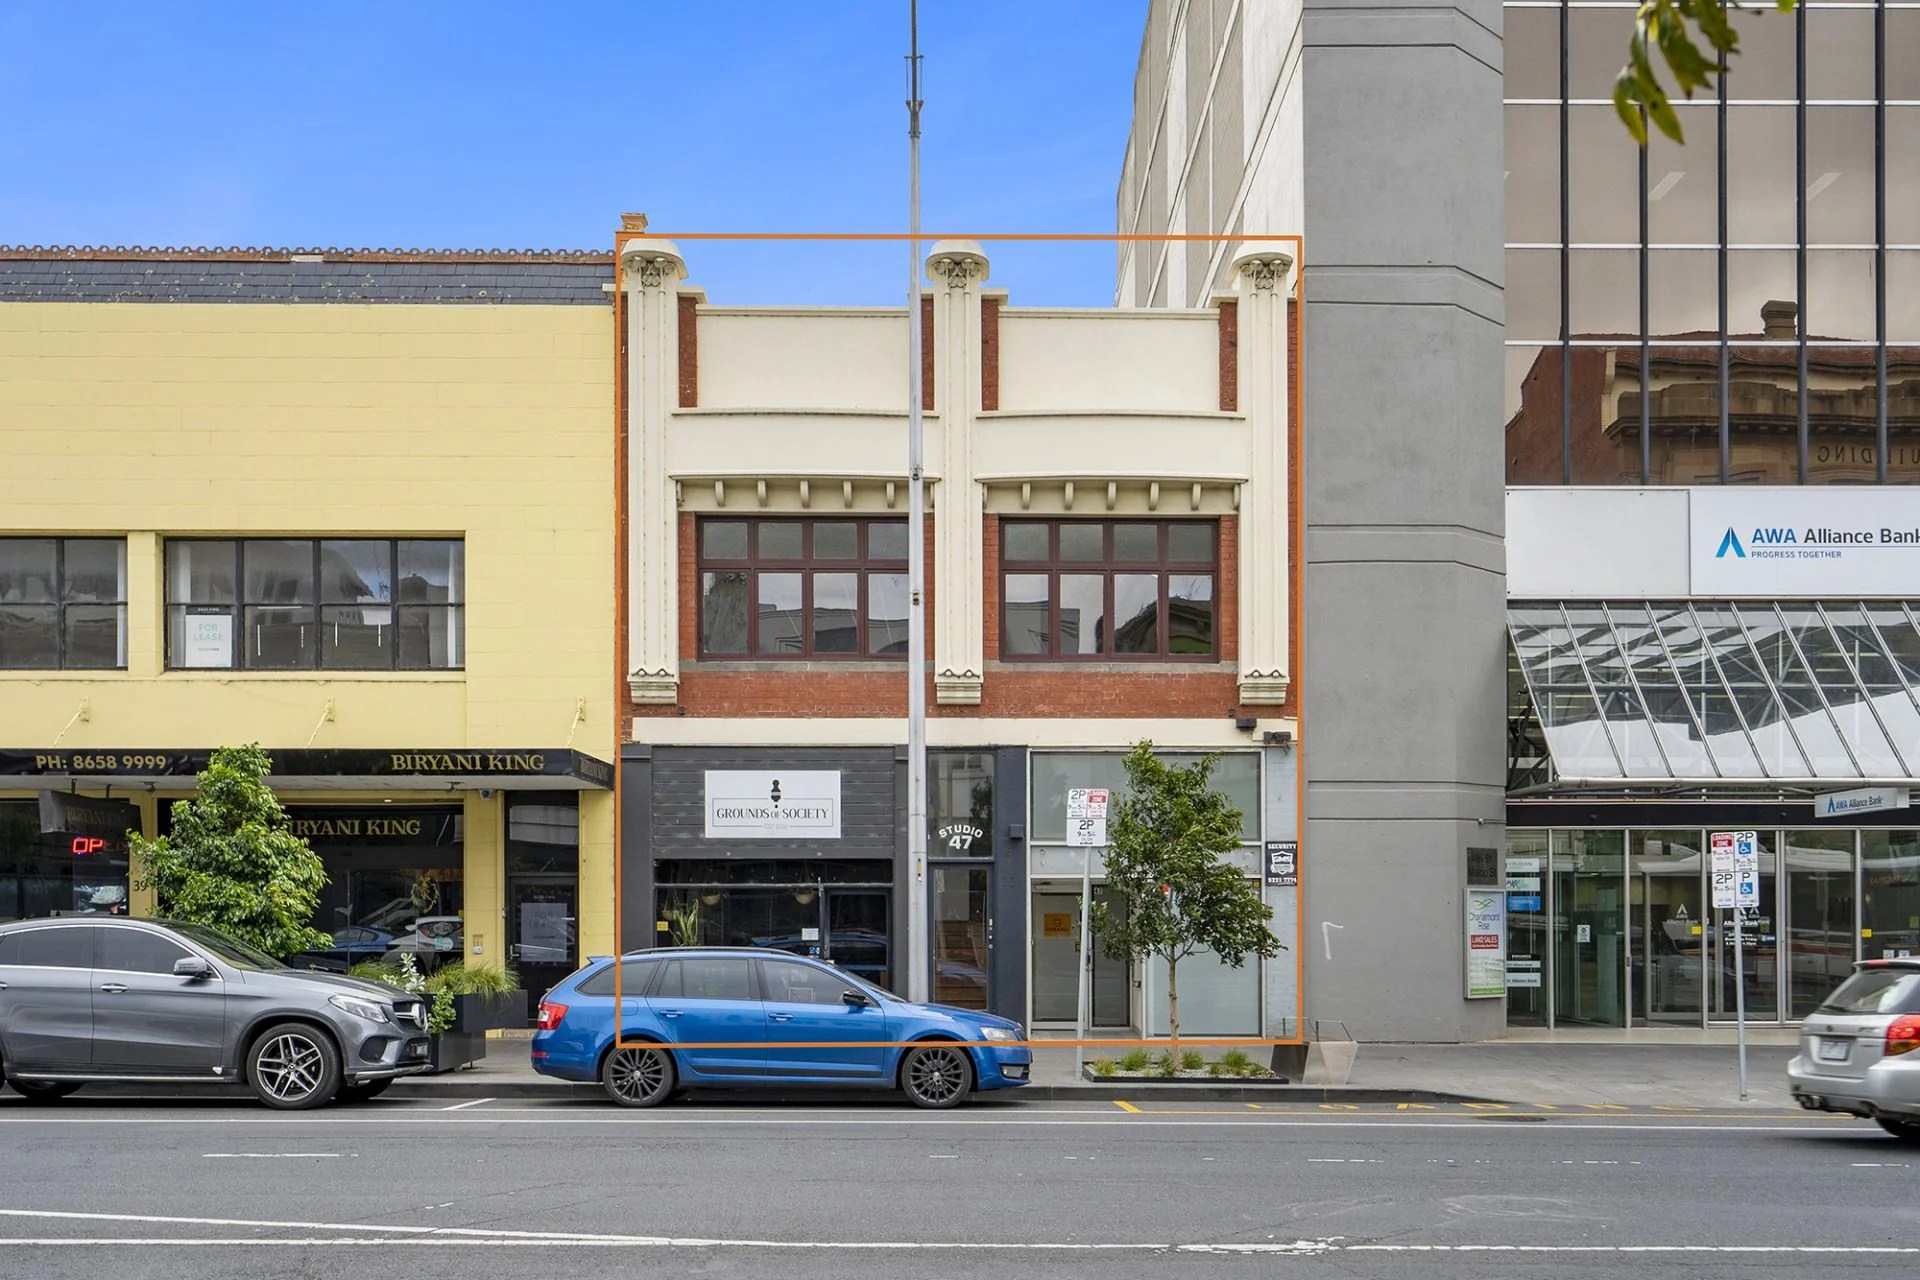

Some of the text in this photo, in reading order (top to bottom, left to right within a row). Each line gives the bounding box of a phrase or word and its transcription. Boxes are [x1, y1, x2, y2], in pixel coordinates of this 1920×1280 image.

[1752, 528, 1797, 544] AWA
[1804, 528, 1873, 544] Alliance
[194, 633, 224, 641] LEASE
[36, 755, 167, 769] PH: 8658 9999
[391, 754, 545, 770] BIRYANI KING
[1071, 790, 1086, 800] 2P
[1848, 799, 1868, 809] Alliance
[1868, 796, 1884, 806] Bank
[716, 808, 770, 819] GROUNDS
[782, 808, 828, 819] SOCIETY
[279, 820, 421, 835] IRYANI KING
[938, 824, 984, 838] STUDIO
[1079, 820, 1095, 830] 2P
[949, 835, 973, 849] 47
[1736, 833, 1754, 842] 2P
[1715, 874, 1733, 884] 2P
[1742, 873, 1751, 882] P
